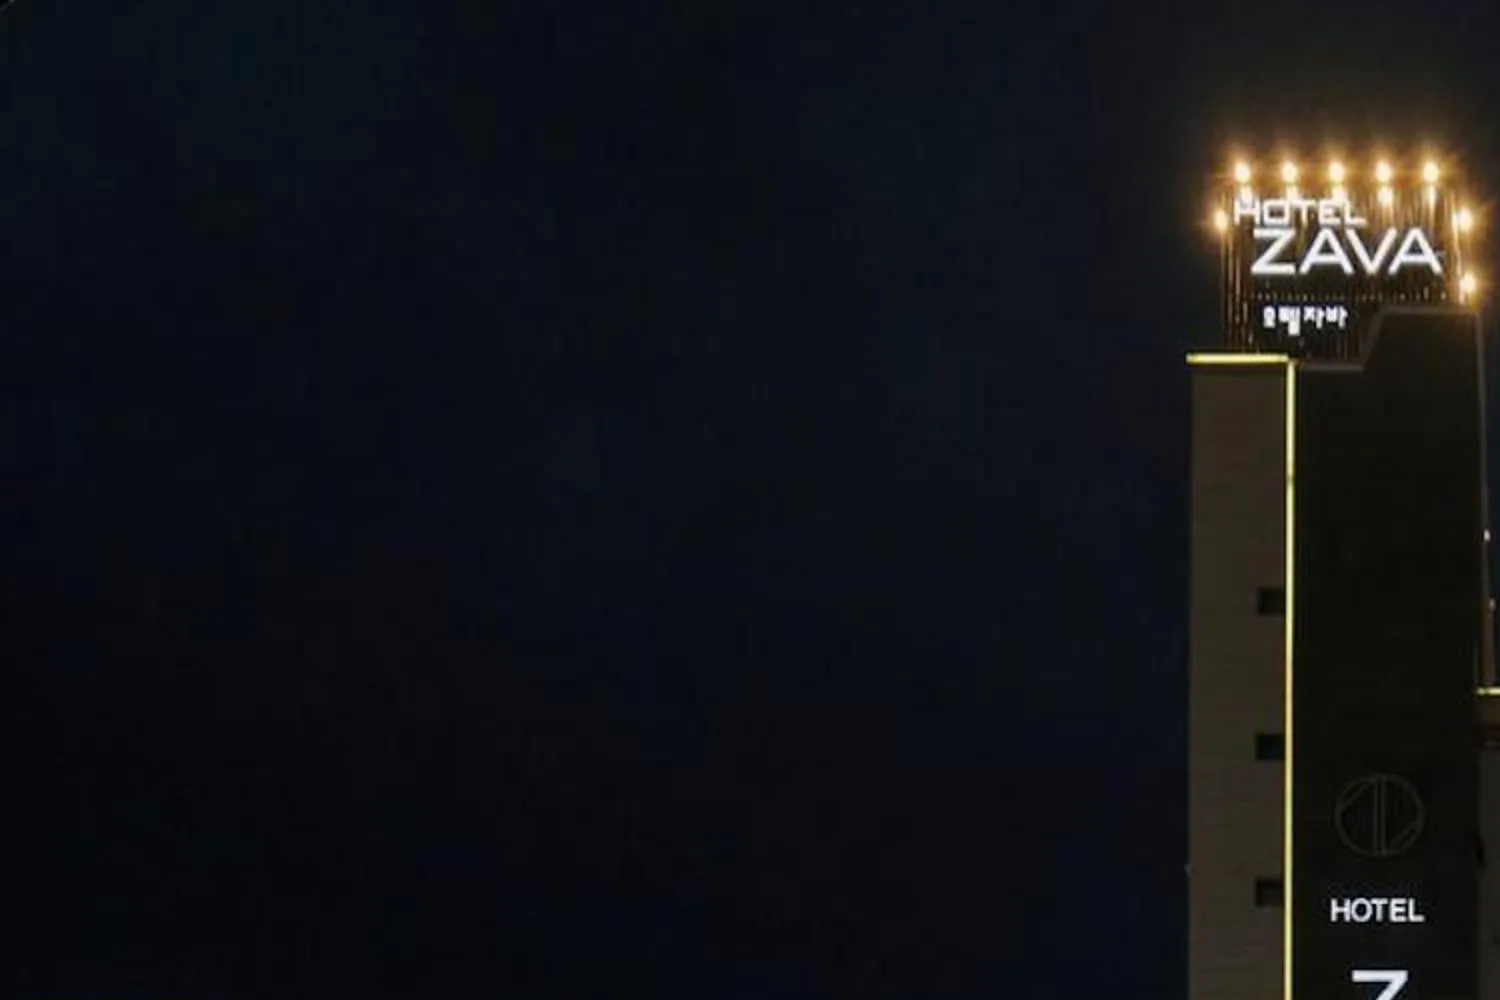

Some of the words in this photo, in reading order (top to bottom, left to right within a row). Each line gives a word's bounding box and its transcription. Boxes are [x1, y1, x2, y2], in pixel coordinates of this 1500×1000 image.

[1233, 197, 1367, 226] HOTEL
[1250, 228, 1442, 275] ZAVA
[1330, 897, 1426, 923] HOTEL
